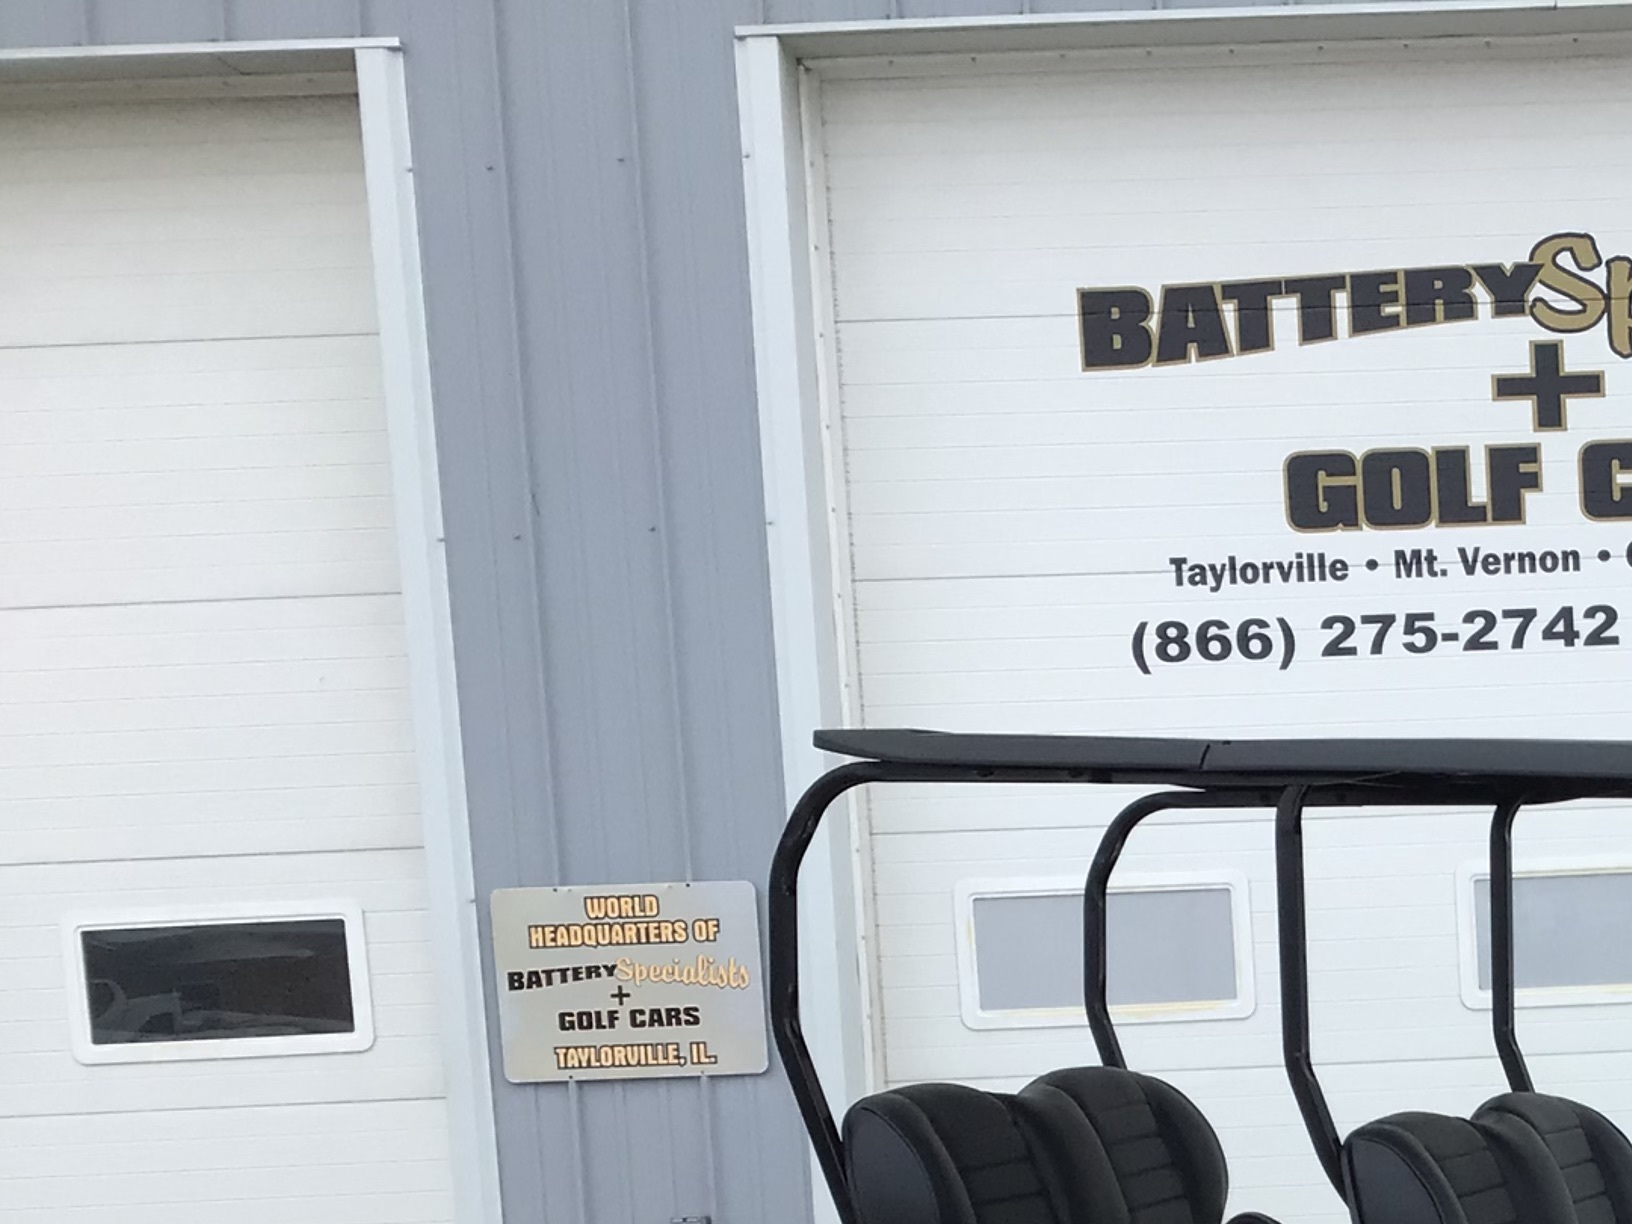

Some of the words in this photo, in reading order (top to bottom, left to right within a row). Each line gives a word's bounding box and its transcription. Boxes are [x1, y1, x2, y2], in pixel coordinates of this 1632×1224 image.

[1076, 261, 1548, 371] BATTERY
[1283, 442, 1543, 534] GOLF
[1169, 552, 1350, 592] Taylorville
[1393, 548, 1449, 581] Mt.
[1458, 545, 1582, 577] Vernon
[1130, 617, 1297, 676] (866)
[1319, 605, 1621, 659] 275-2742
[584, 894, 659, 919] WORLD
[528, 920, 688, 949] HEADQUARTERS
[692, 918, 719, 943] OF
[507, 964, 617, 991] BATTERY
[615, 955, 749, 990] Specialists
[558, 1010, 620, 1031] GOLF
[629, 1007, 701, 1029] CARS
[554, 1043, 687, 1069] TAYLORVILLE,
[690, 1041, 717, 1064] IL.
